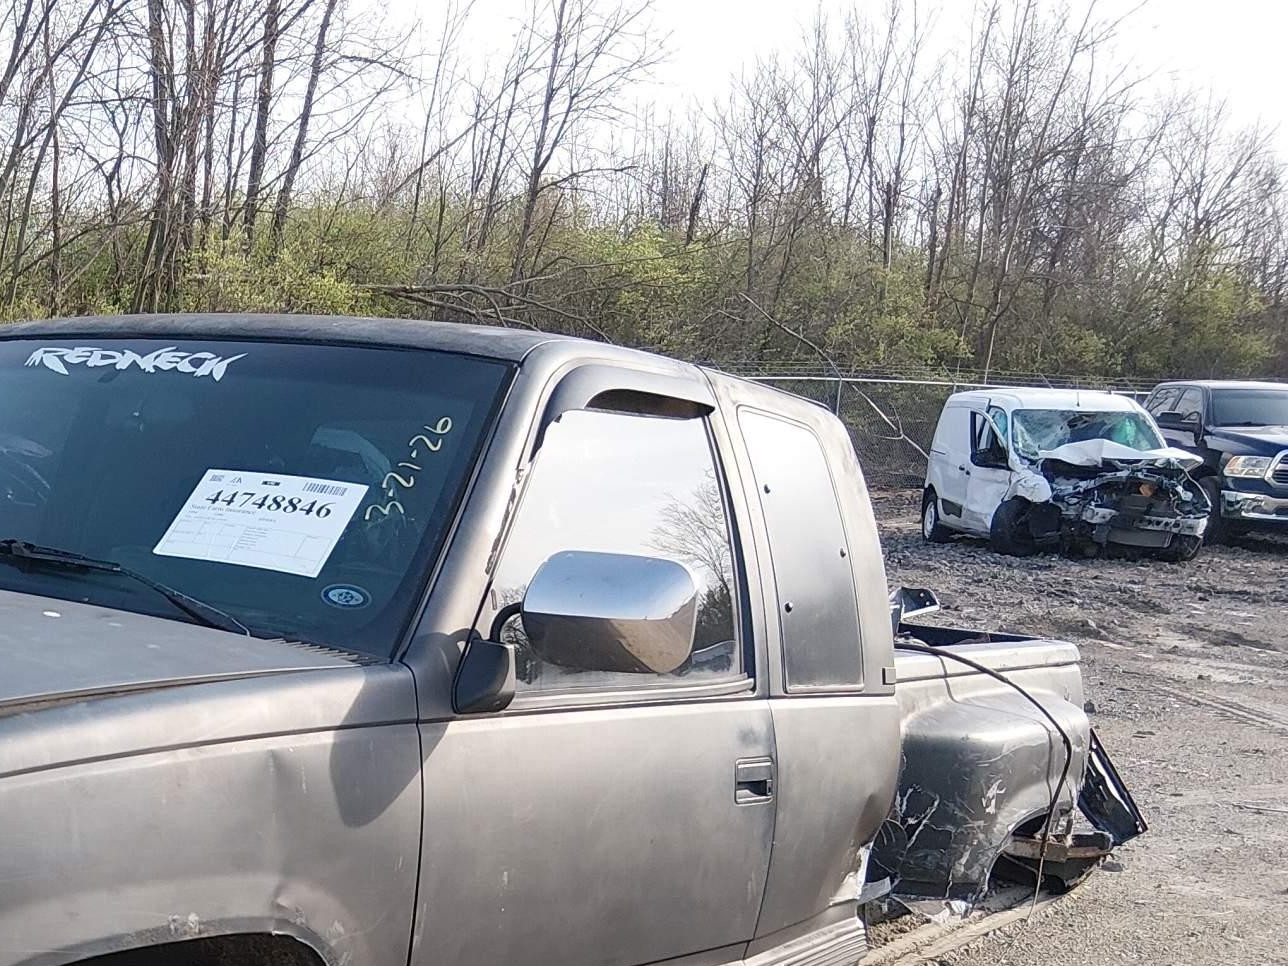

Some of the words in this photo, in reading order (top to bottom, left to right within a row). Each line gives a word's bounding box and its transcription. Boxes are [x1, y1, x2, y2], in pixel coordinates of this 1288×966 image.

[24, 346, 248, 382] REDNECK
[364, 416, 453, 521] 3-21-26
[205, 490, 336, 519] 44748846
